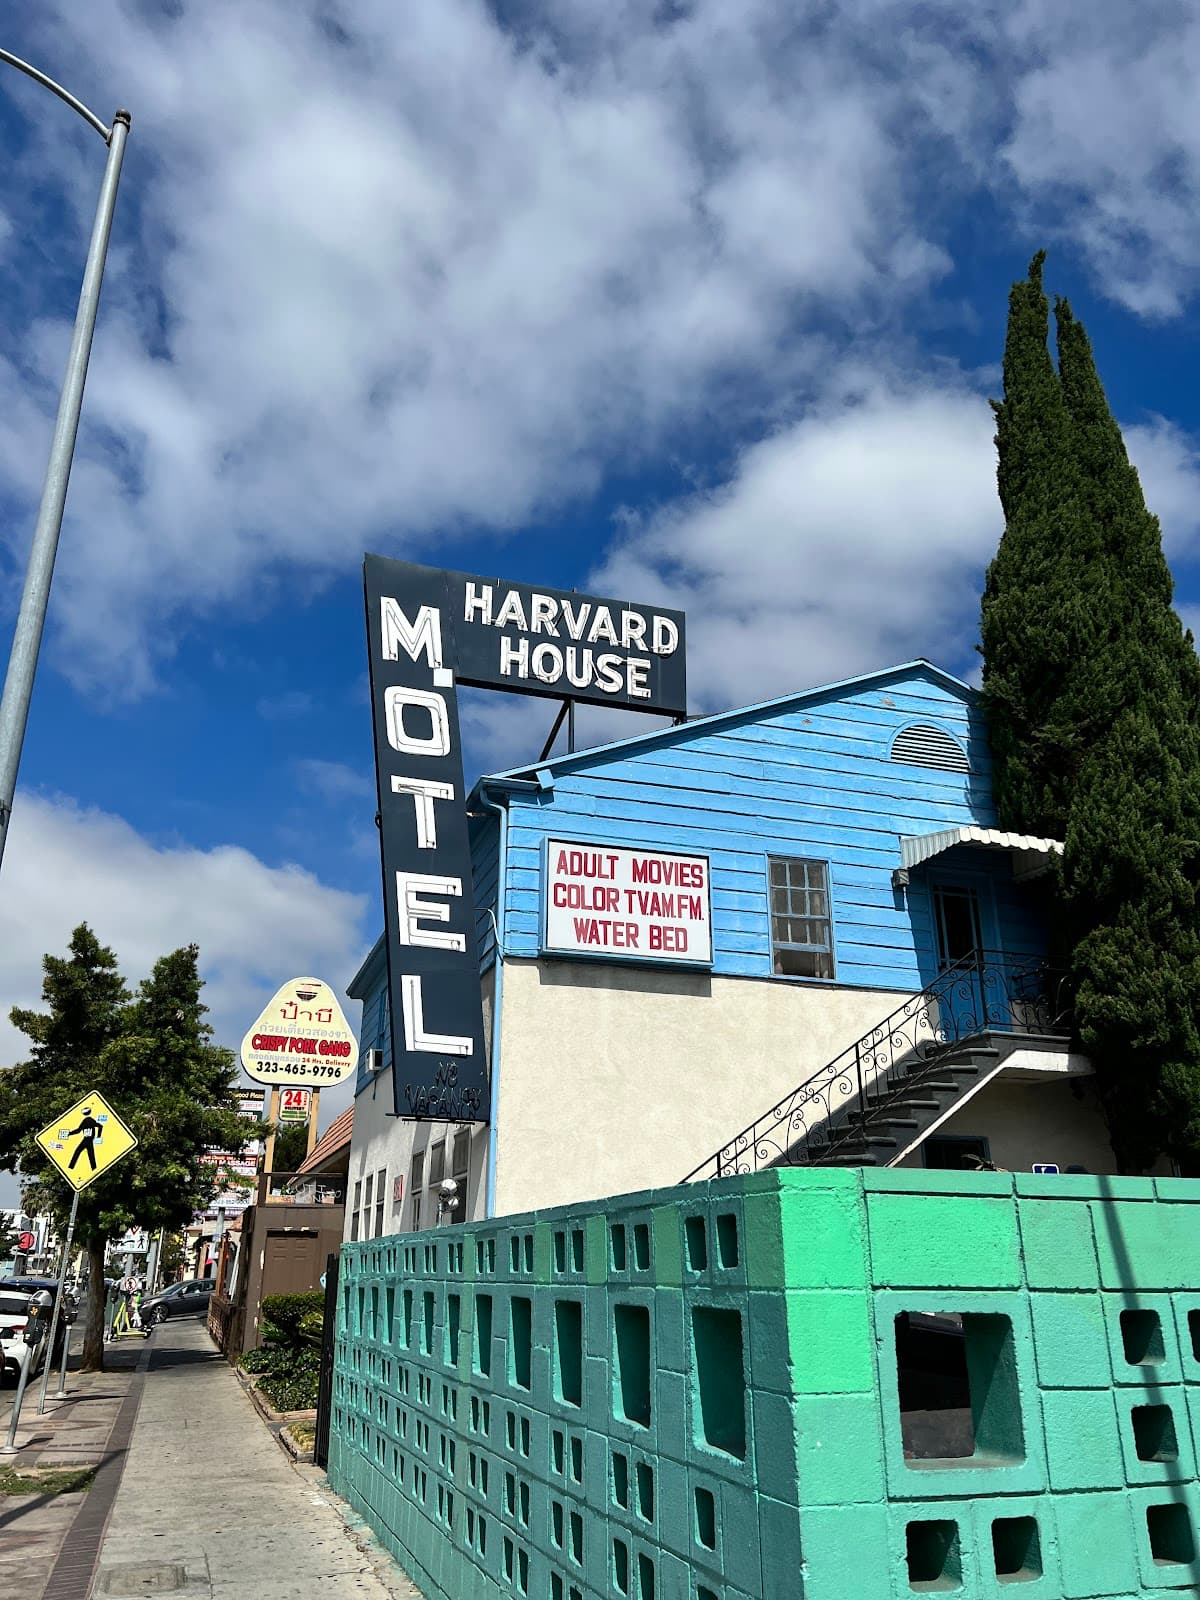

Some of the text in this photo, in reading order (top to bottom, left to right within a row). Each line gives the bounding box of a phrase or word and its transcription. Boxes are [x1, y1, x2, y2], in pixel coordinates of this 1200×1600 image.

[464, 581, 679, 655] HARVARD
[500, 635, 652, 699] HOUSE
[379, 595, 474, 1056] MOTEL
[556, 849, 704, 889] ADULT MOVIES
[553, 882, 620, 913] COLOR
[573, 917, 688, 953] WATER BED
[252, 1033, 352, 1058] CRISPY PORK GANG
[256, 1061, 342, 1078] 323-465-9796
[325, 1059, 351, 1067] Delivery
[284, 1090, 302, 1106] 24
